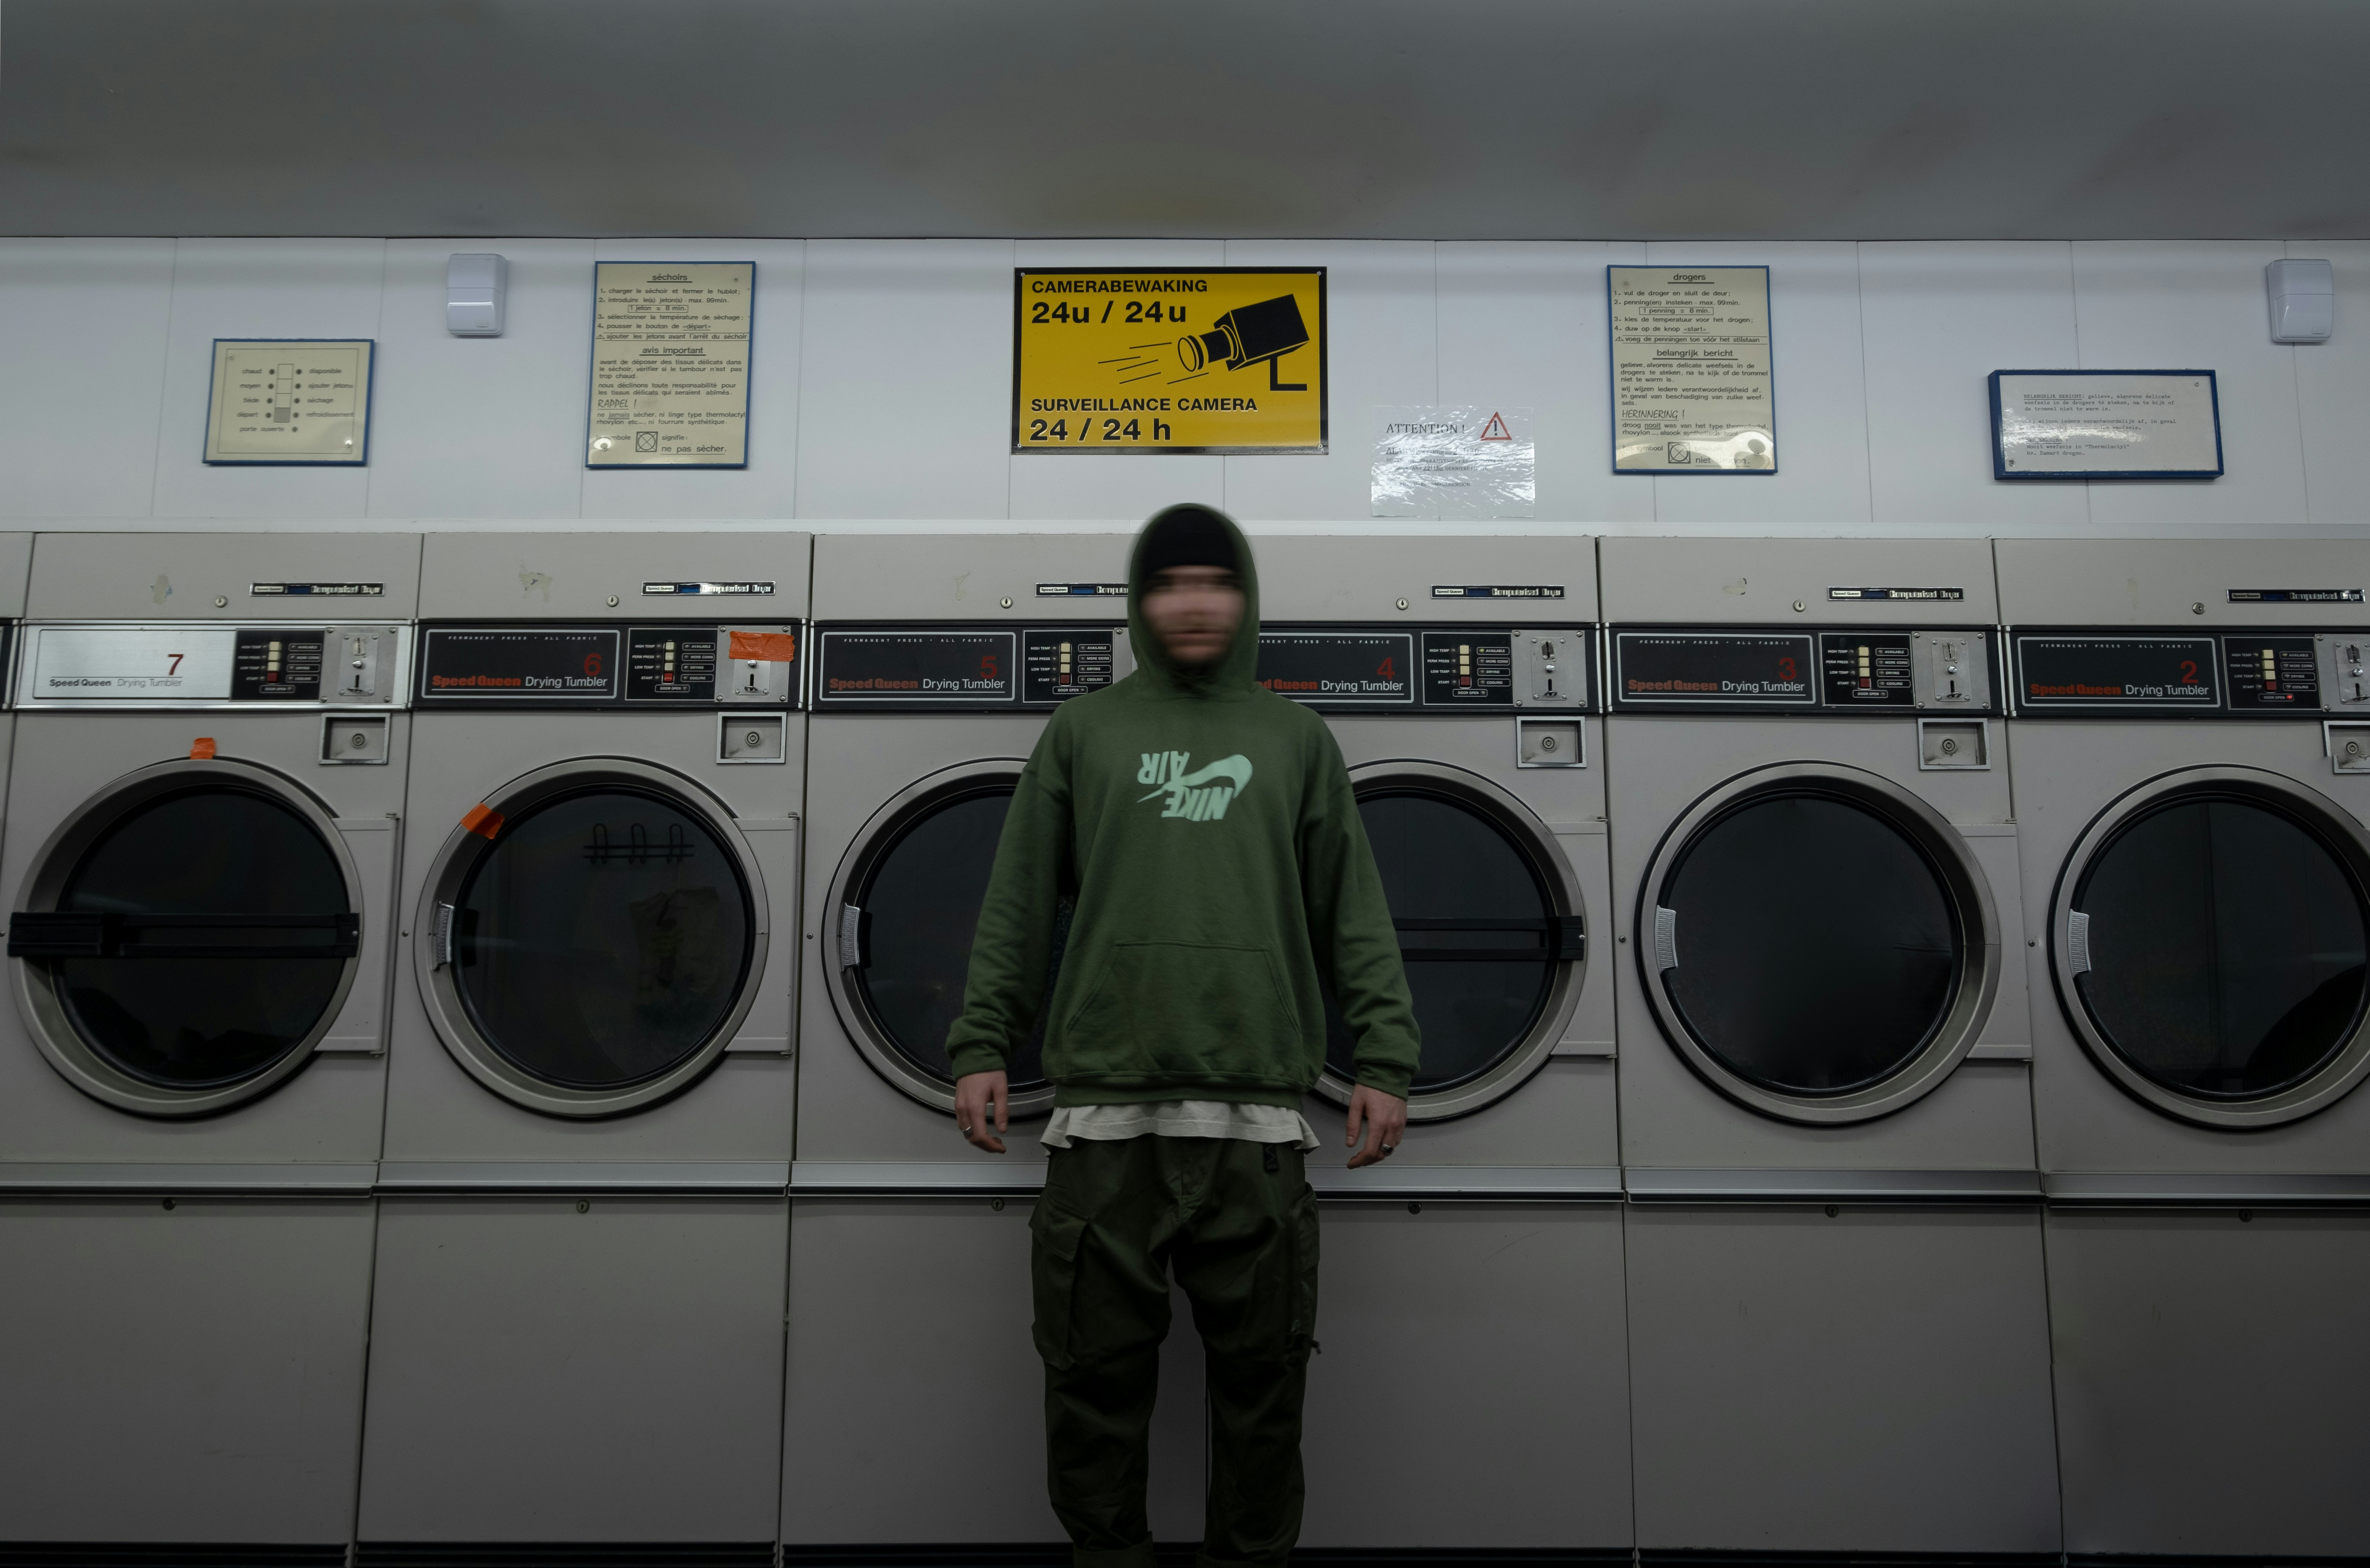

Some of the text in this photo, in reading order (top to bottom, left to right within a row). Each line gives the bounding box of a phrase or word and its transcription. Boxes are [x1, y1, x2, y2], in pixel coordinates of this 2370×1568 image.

[1673, 274, 1706, 282] drogers
[1032, 280, 1207, 293] CAMERABEWAKING
[1032, 302, 1089, 323] 24u
[1657, 349, 1698, 358] belangrijk
[598, 399, 628, 408] RAPPEL
[1031, 398, 1257, 411] SURVEILLANCE CAMERA
[1622, 410, 1678, 419] HERINNERING
[1030, 419, 1068, 440] 24
[1103, 419, 1141, 440] 24
[1154, 418, 1170, 440] h
[1386, 424, 1457, 434] ATTENTION
[168, 654, 184, 676] 7
[584, 653, 602, 676] 6
[980, 656, 997, 679] 5
[1377, 657, 1395, 679] 4
[1779, 657, 1796, 680] 3
[2180, 661, 2199, 683] 2
[50, 679, 79, 687] Speed
[117, 679, 145, 687] Drying
[149, 679, 182, 687] Tumbler
[432, 676, 608, 688] Speed Queen Drying Tumbler
[829, 678, 1005, 690] Speed Queen Drying Tumbler
[1274, 679, 1318, 690] Queen
[1322, 681, 1357, 692] Drying
[1360, 681, 1404, 690] Tumbler
[1628, 680, 1805, 693] Speed Queen Drying Tumbler
[2031, 684, 2209, 696] Speed Queen Drying Tumbler
[1137, 751, 1190, 784] AIR
[1161, 786, 1234, 821] NIKE
